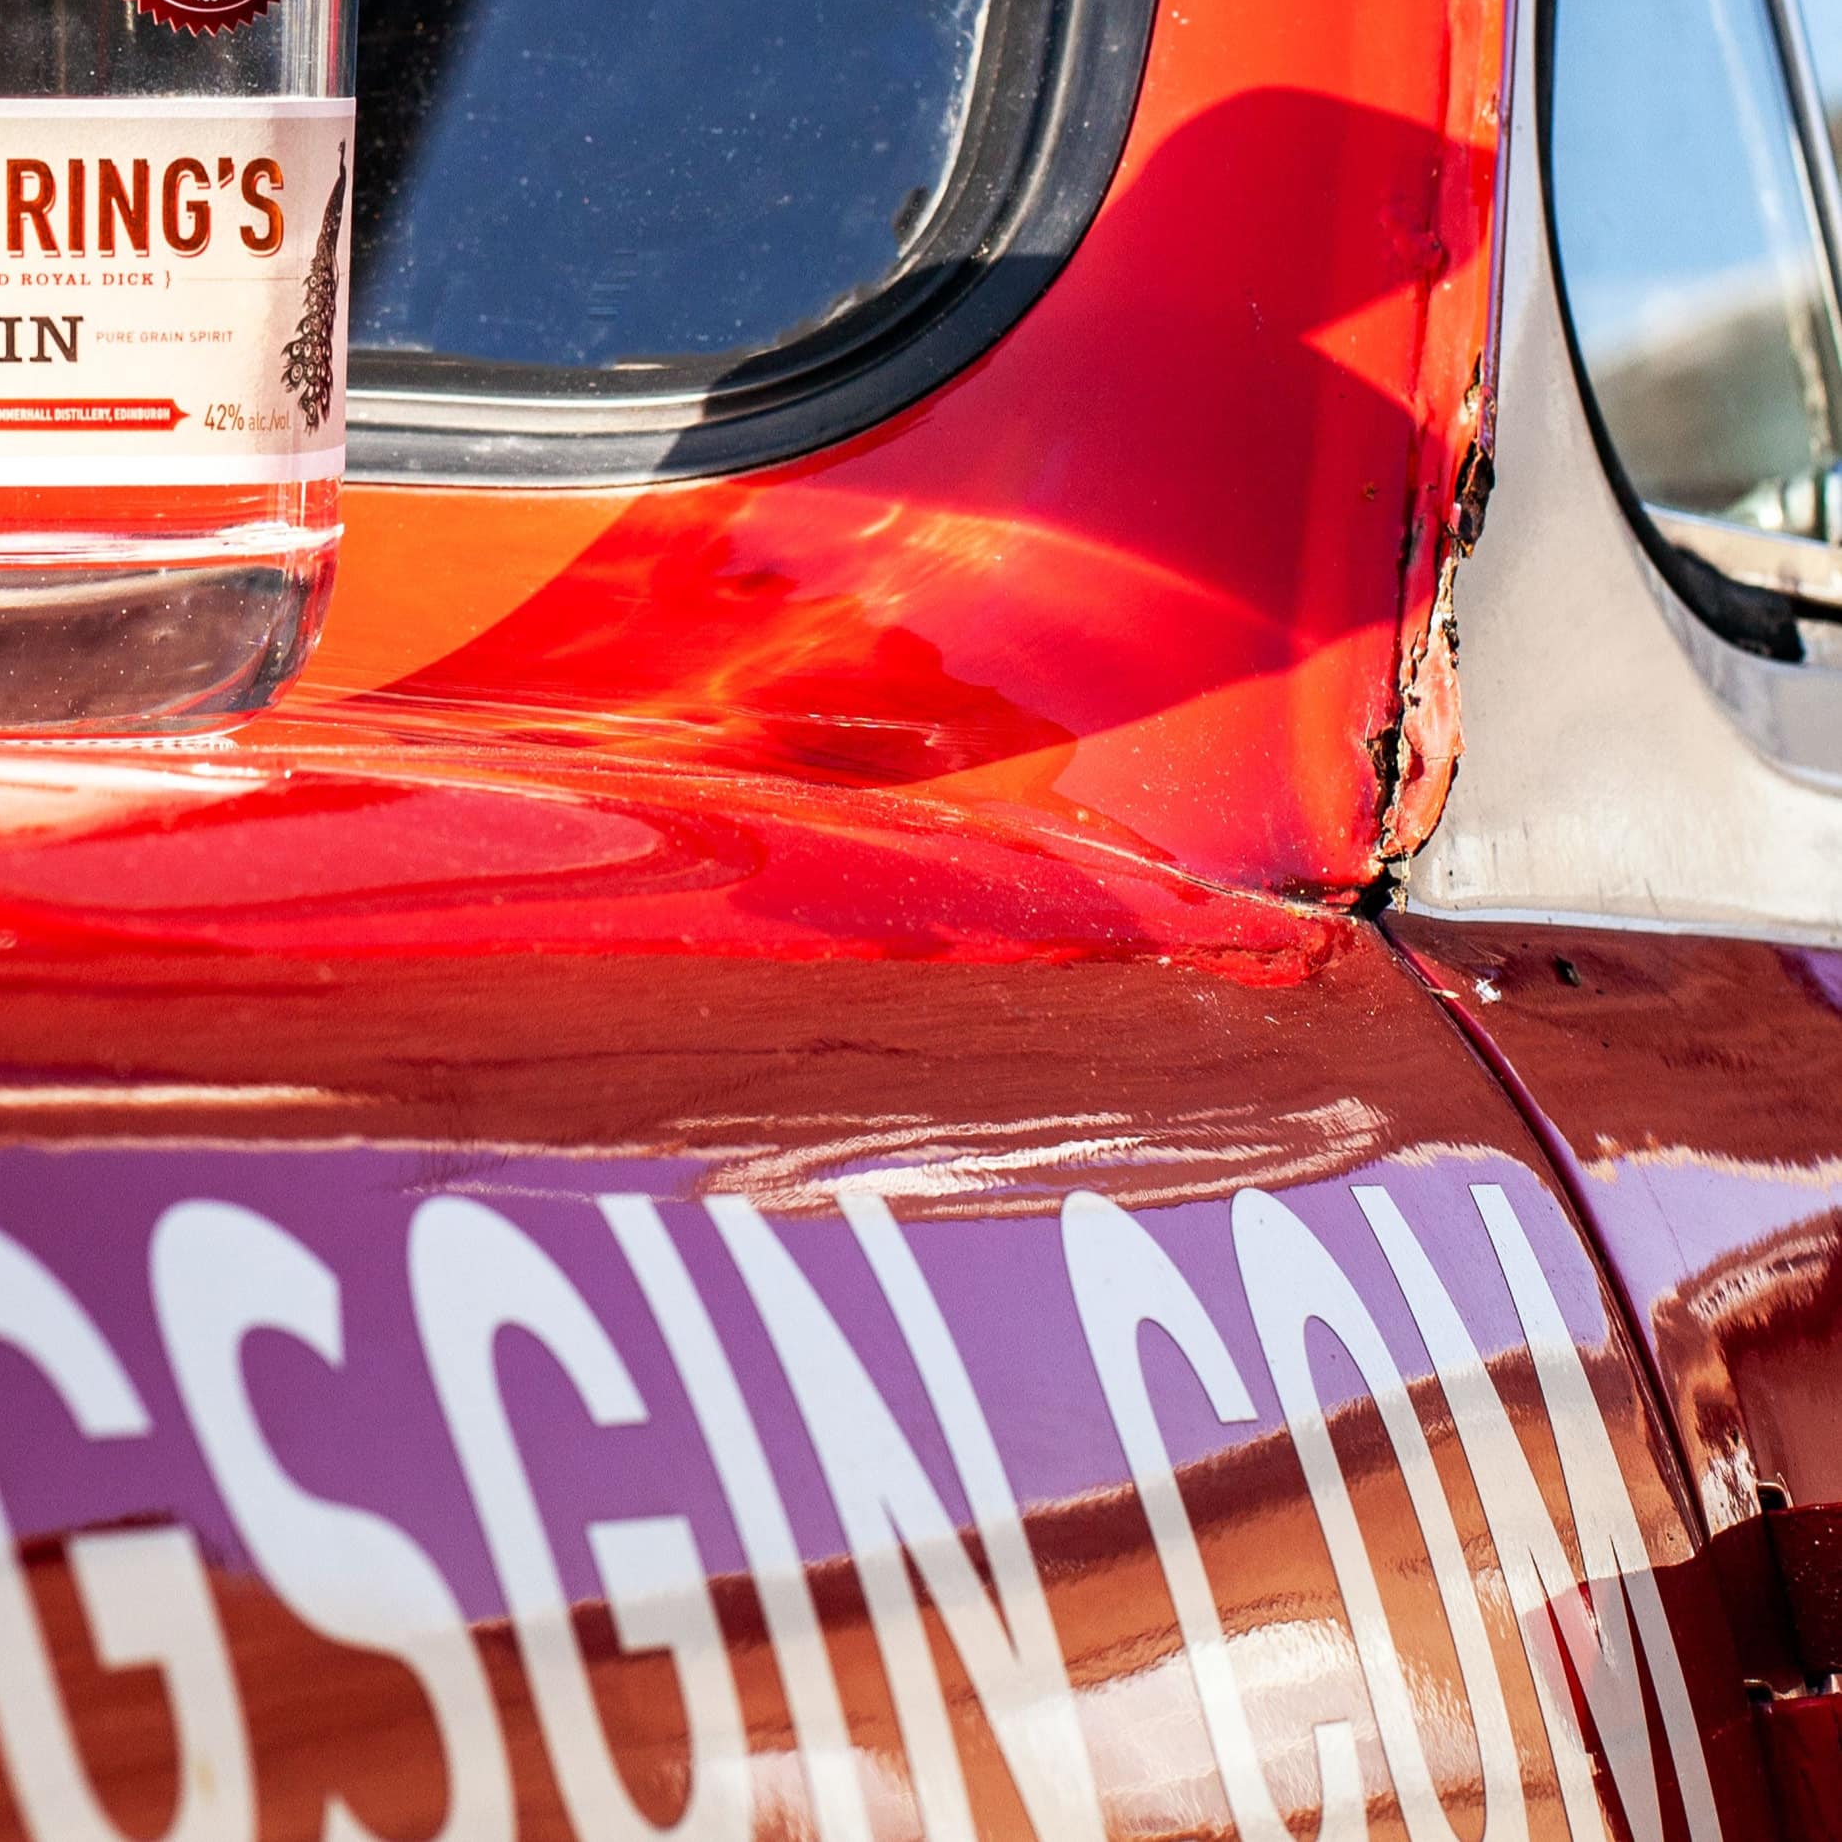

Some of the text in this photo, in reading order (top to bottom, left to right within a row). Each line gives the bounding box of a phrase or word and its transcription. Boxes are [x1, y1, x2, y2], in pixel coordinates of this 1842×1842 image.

[21, 273, 91, 286] ROYAL
[102, 273, 154, 286] DICK
[95, 330, 234, 344] PURE GRAIN SPIRIT
[54, 407, 113, 423] DISTILLERY,
[114, 407, 170, 421] EDINBURGH
[204, 403, 245, 431] 42%
